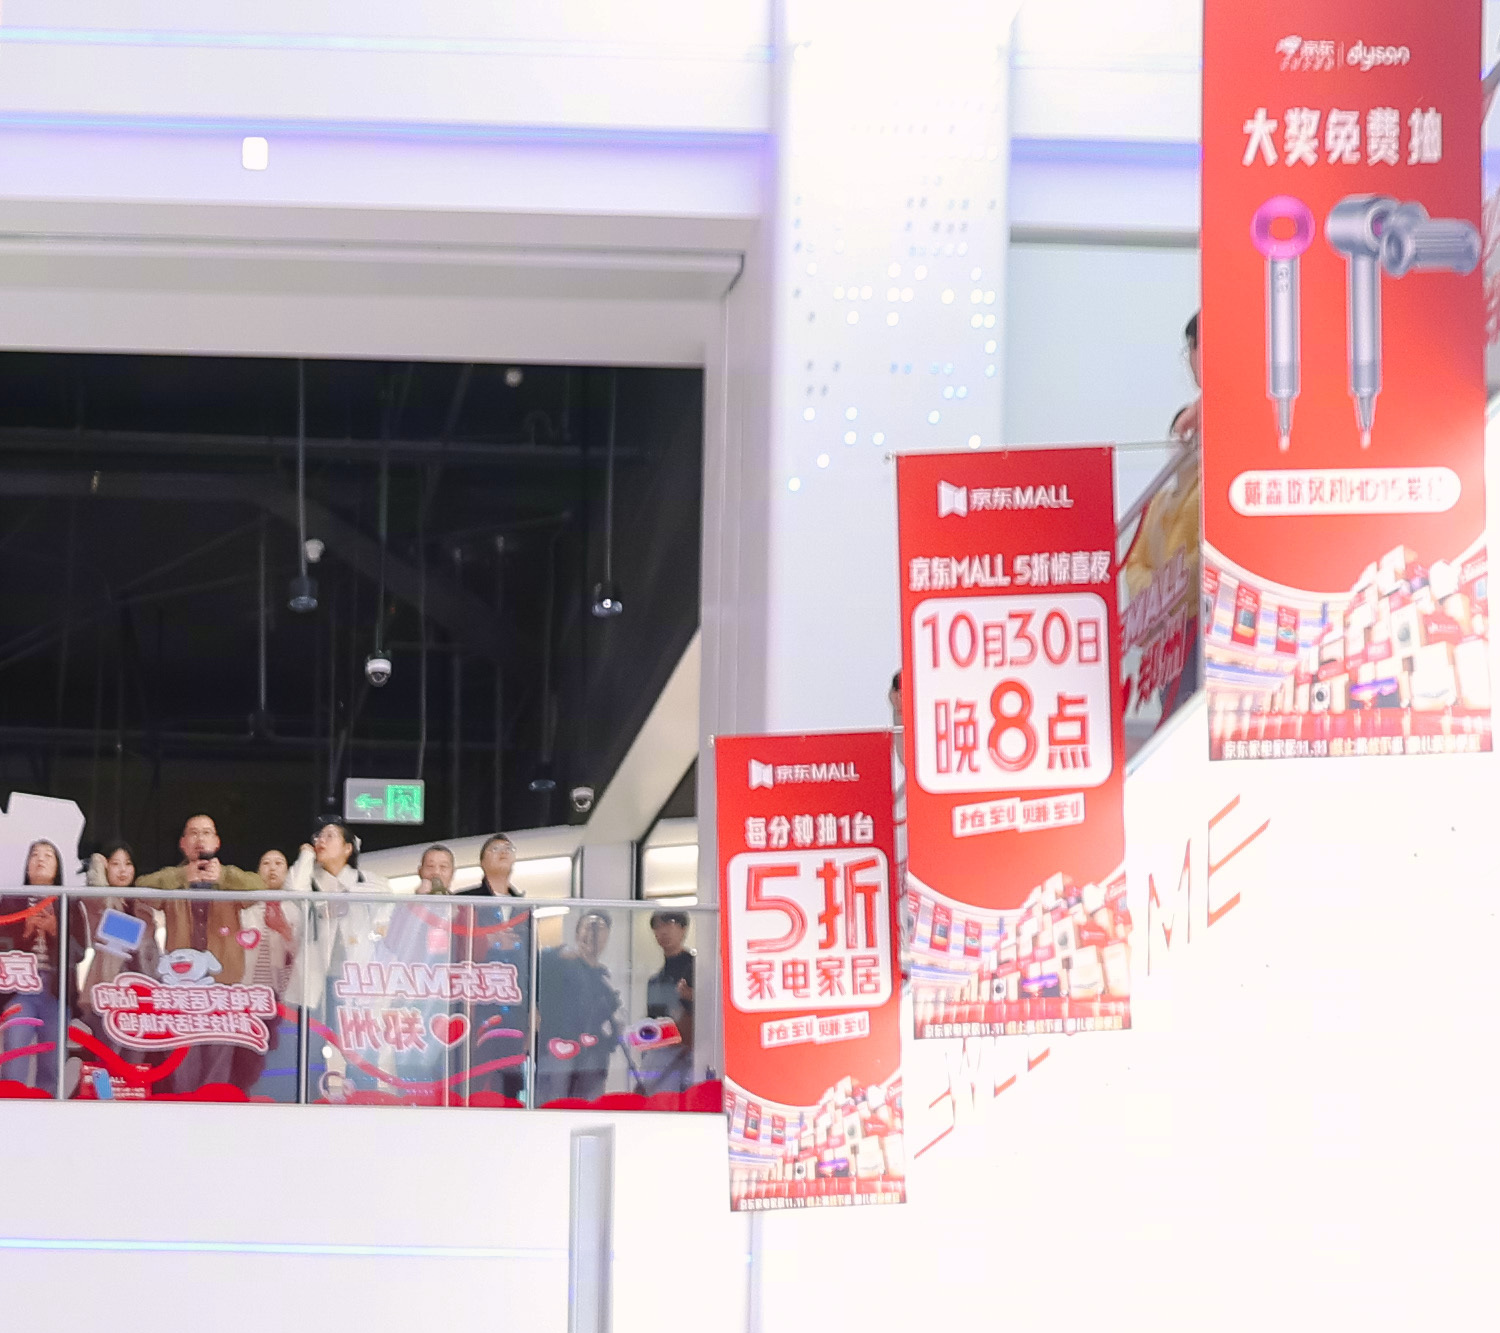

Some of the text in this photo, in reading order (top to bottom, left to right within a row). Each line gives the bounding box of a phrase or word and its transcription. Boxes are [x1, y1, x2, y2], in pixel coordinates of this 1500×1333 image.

[1347, 40, 1410, 71] dyson
[1242, 107, 1443, 167] 大奖免费抽
[970, 484, 1074, 512] 京东MALL
[909, 551, 1111, 592] 京东MALL 5折惊喜夜
[922, 607, 1100, 669] 10月30日
[935, 678, 1091, 774] 晚8点
[775, 761, 860, 783] 京东MALL
[744, 812, 875, 849] 每分钟抽1台
[745, 858, 880, 954] 5折
[745, 957, 882, 1001] 家电家居
